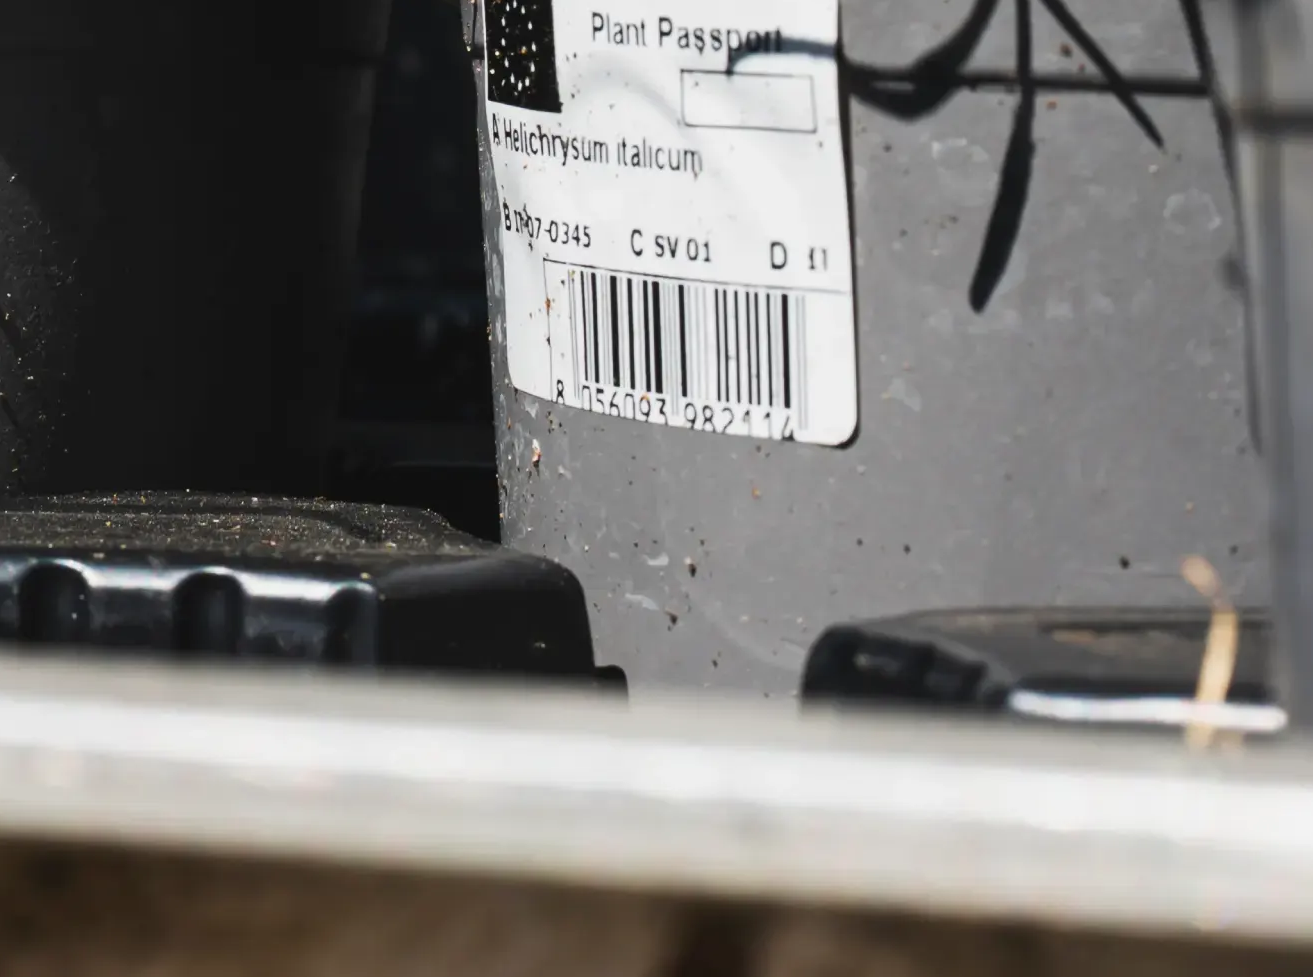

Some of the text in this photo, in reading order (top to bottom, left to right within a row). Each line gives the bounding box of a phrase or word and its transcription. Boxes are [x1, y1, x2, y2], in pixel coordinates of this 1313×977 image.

[592, 12, 783, 59] Plant Passport
[493, 113, 703, 174] A Helichrysum italicum
[503, 202, 511, 231] B
[631, 229, 643, 257] C
[770, 241, 787, 270] D
[556, 379, 565, 405] 8
